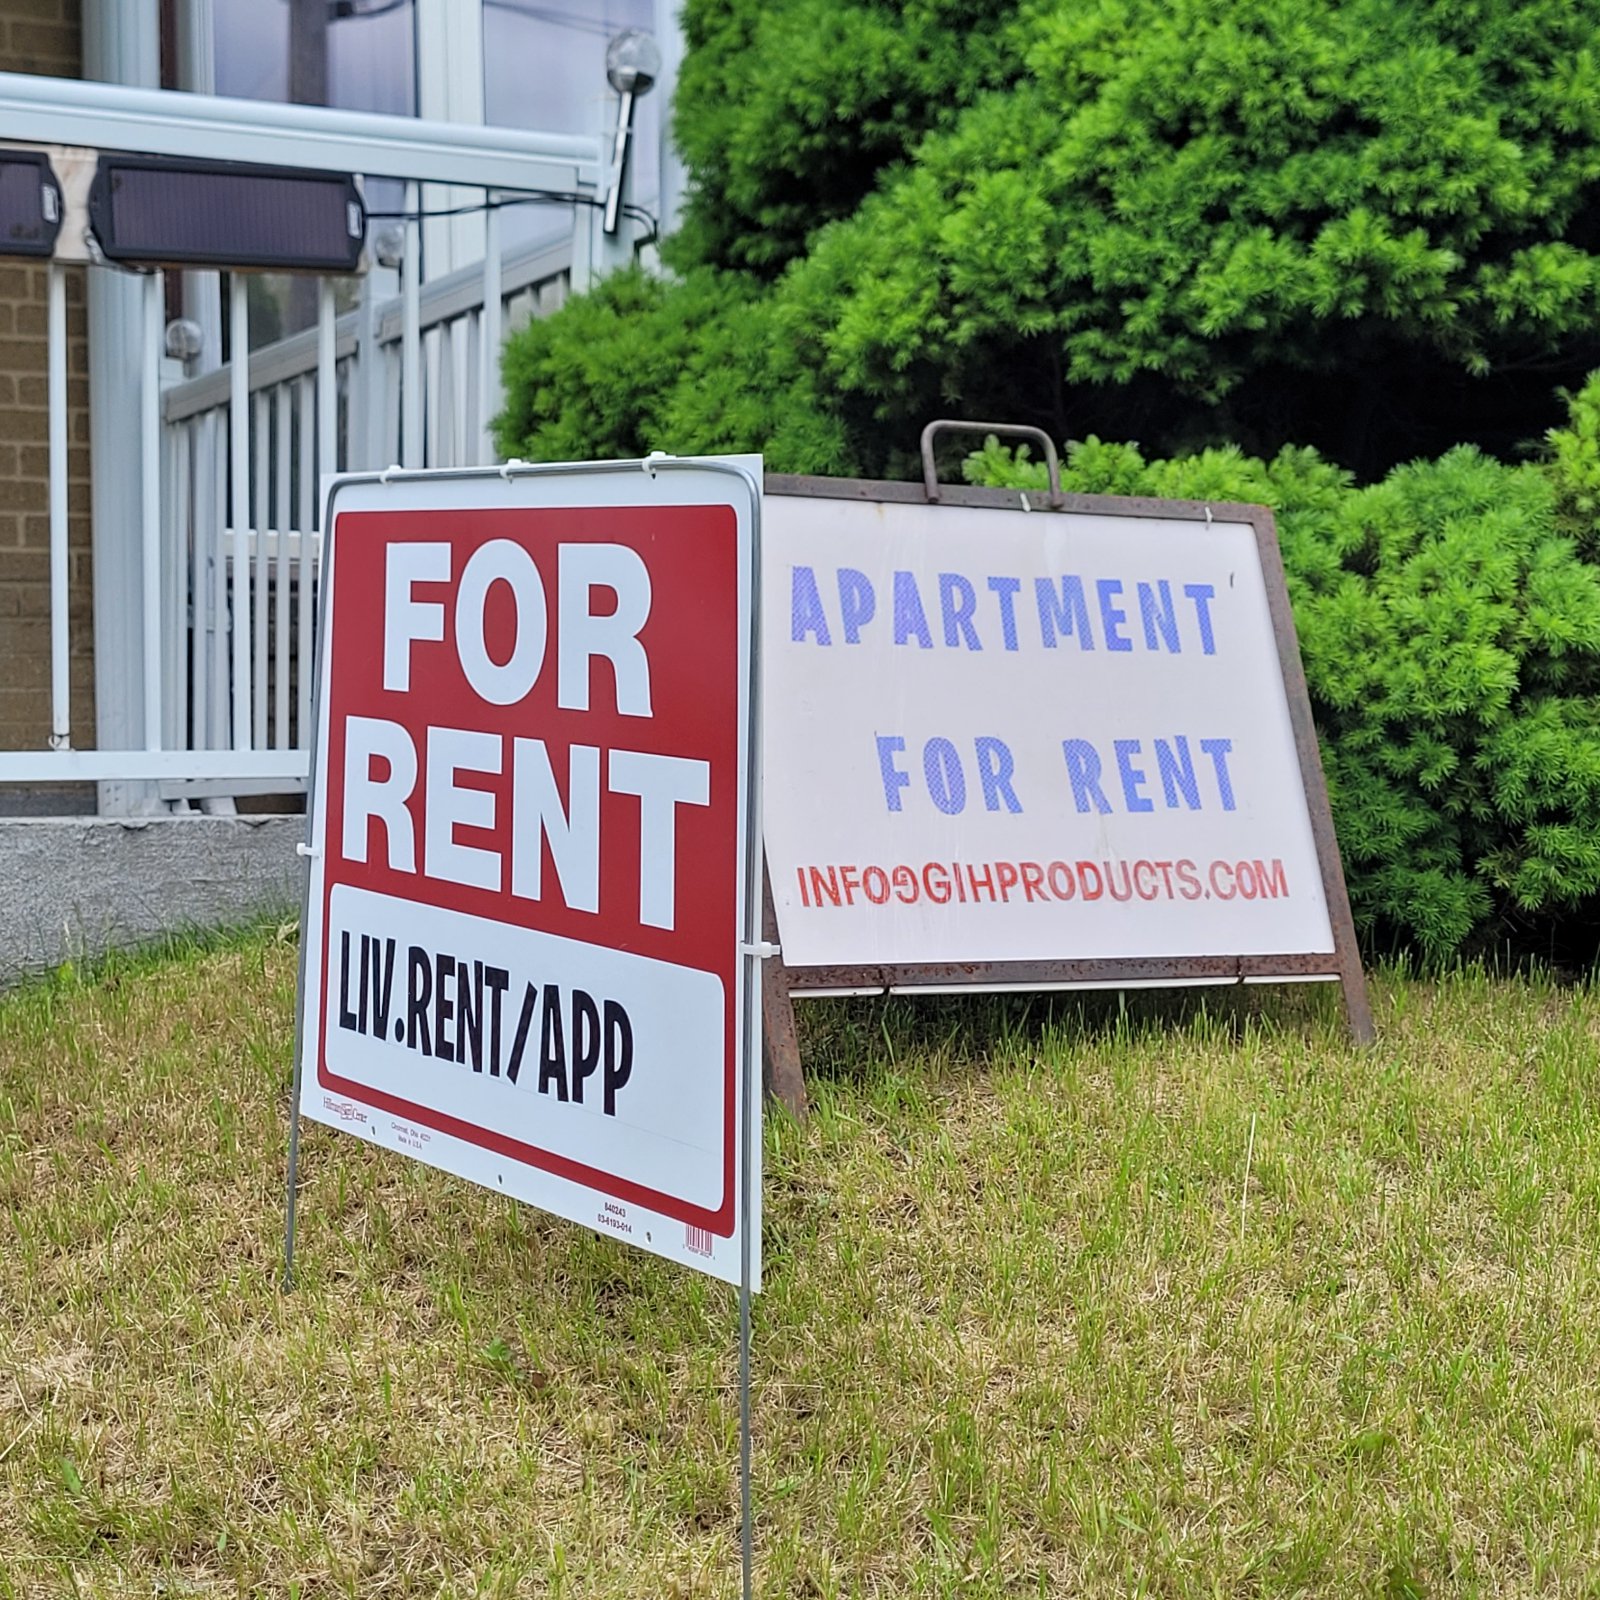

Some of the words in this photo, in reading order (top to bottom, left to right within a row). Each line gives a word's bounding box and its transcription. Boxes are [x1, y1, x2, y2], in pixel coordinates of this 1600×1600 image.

[383, 538, 653, 718] FOR
[790, 565, 1217, 656] APARTMENT
[341, 714, 711, 931] RENT
[874, 735, 1024, 815] FOR
[1061, 735, 1236, 815] RENT
[338, 929, 634, 1118] LIV.RENT/APP
